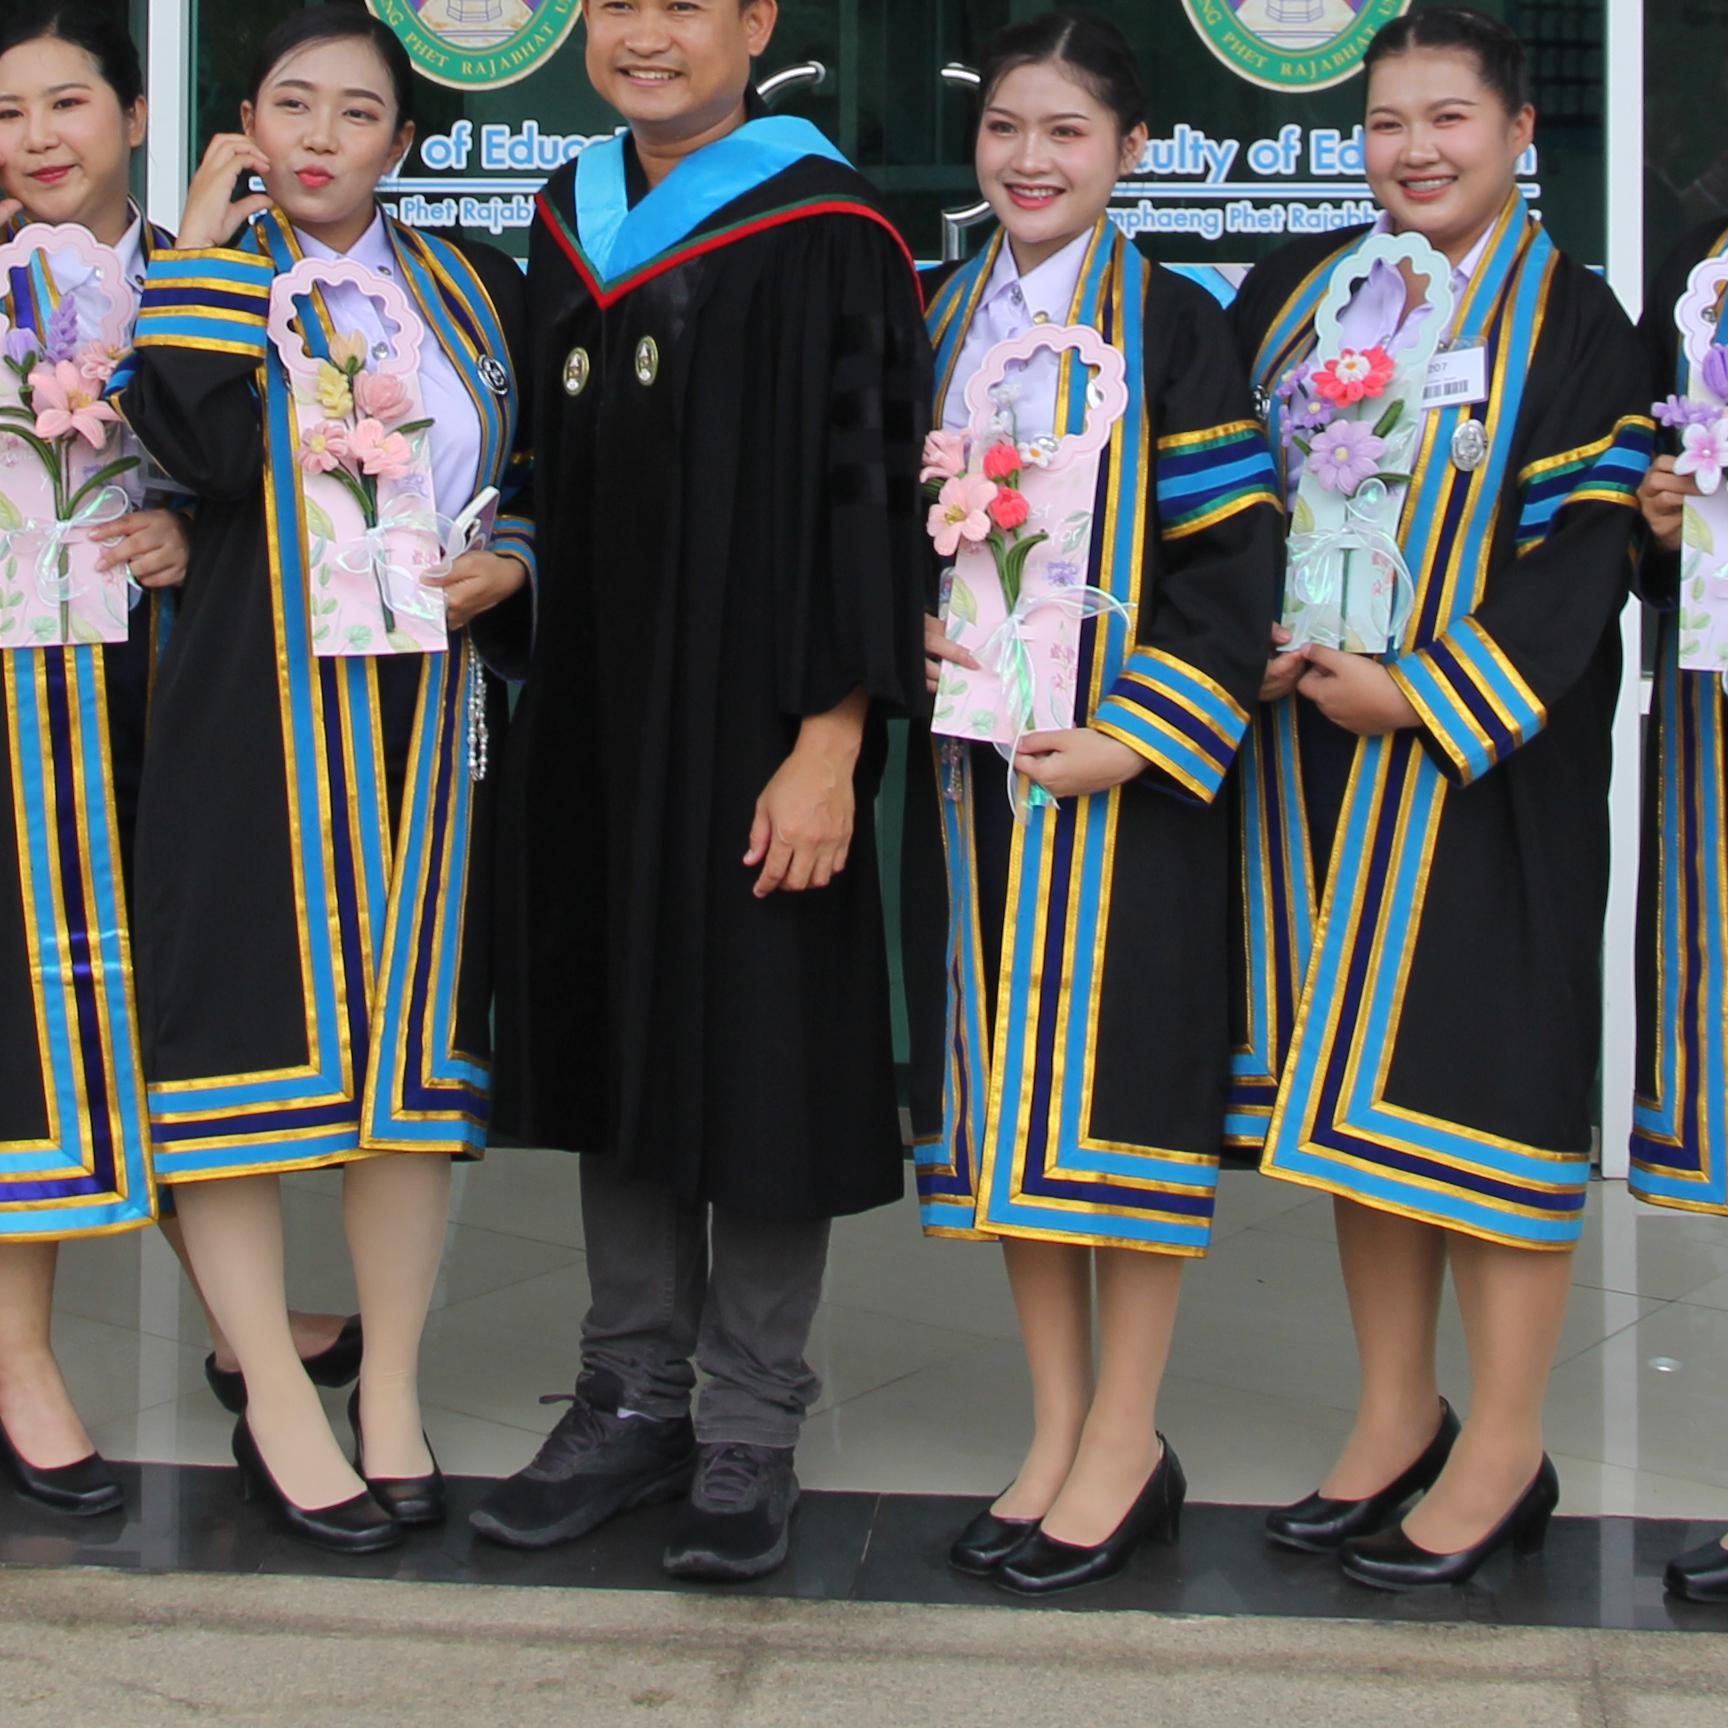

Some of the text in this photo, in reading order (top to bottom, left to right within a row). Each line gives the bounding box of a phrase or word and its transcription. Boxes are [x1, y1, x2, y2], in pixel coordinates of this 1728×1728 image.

[404, 31, 450, 68] PHET
[460, 22, 555, 78] RAJABHAT
[1222, 30, 1271, 70] PHET
[1279, 25, 1379, 80] RAJABHAT
[421, 120, 473, 169] of
[1247, 122, 1303, 175] of
[402, 194, 457, 226] Phet
[1224, 200, 1288, 234] Phet
